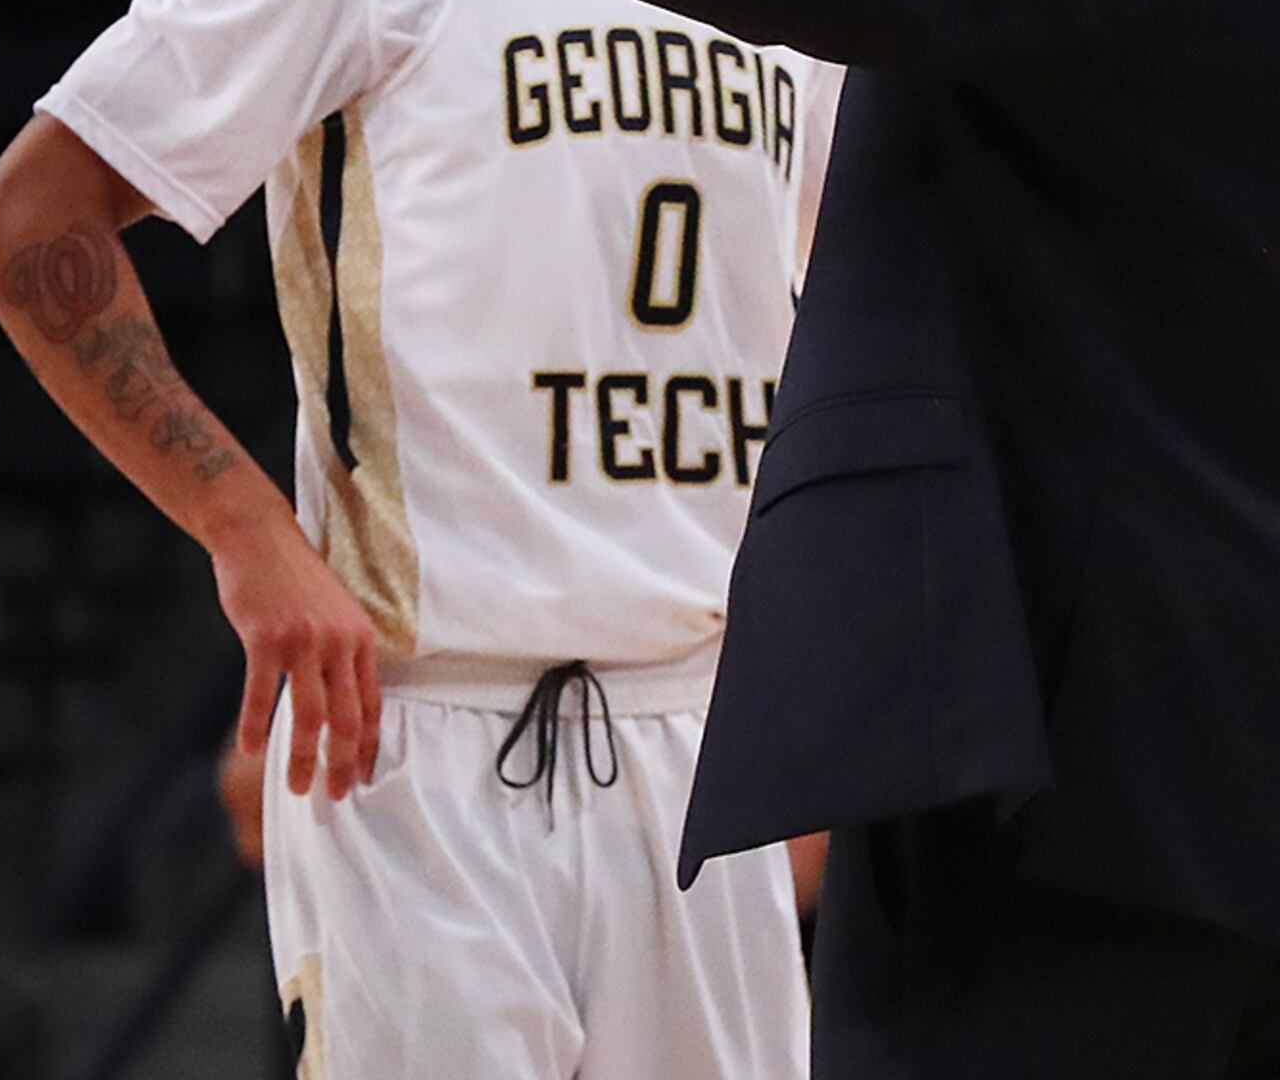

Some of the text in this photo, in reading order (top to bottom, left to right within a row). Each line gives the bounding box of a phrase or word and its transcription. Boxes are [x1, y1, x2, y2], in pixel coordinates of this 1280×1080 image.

[503, 26, 797, 183] GEORGIA
[627, 177, 701, 332] 0
[531, 371, 777, 488] TECH
